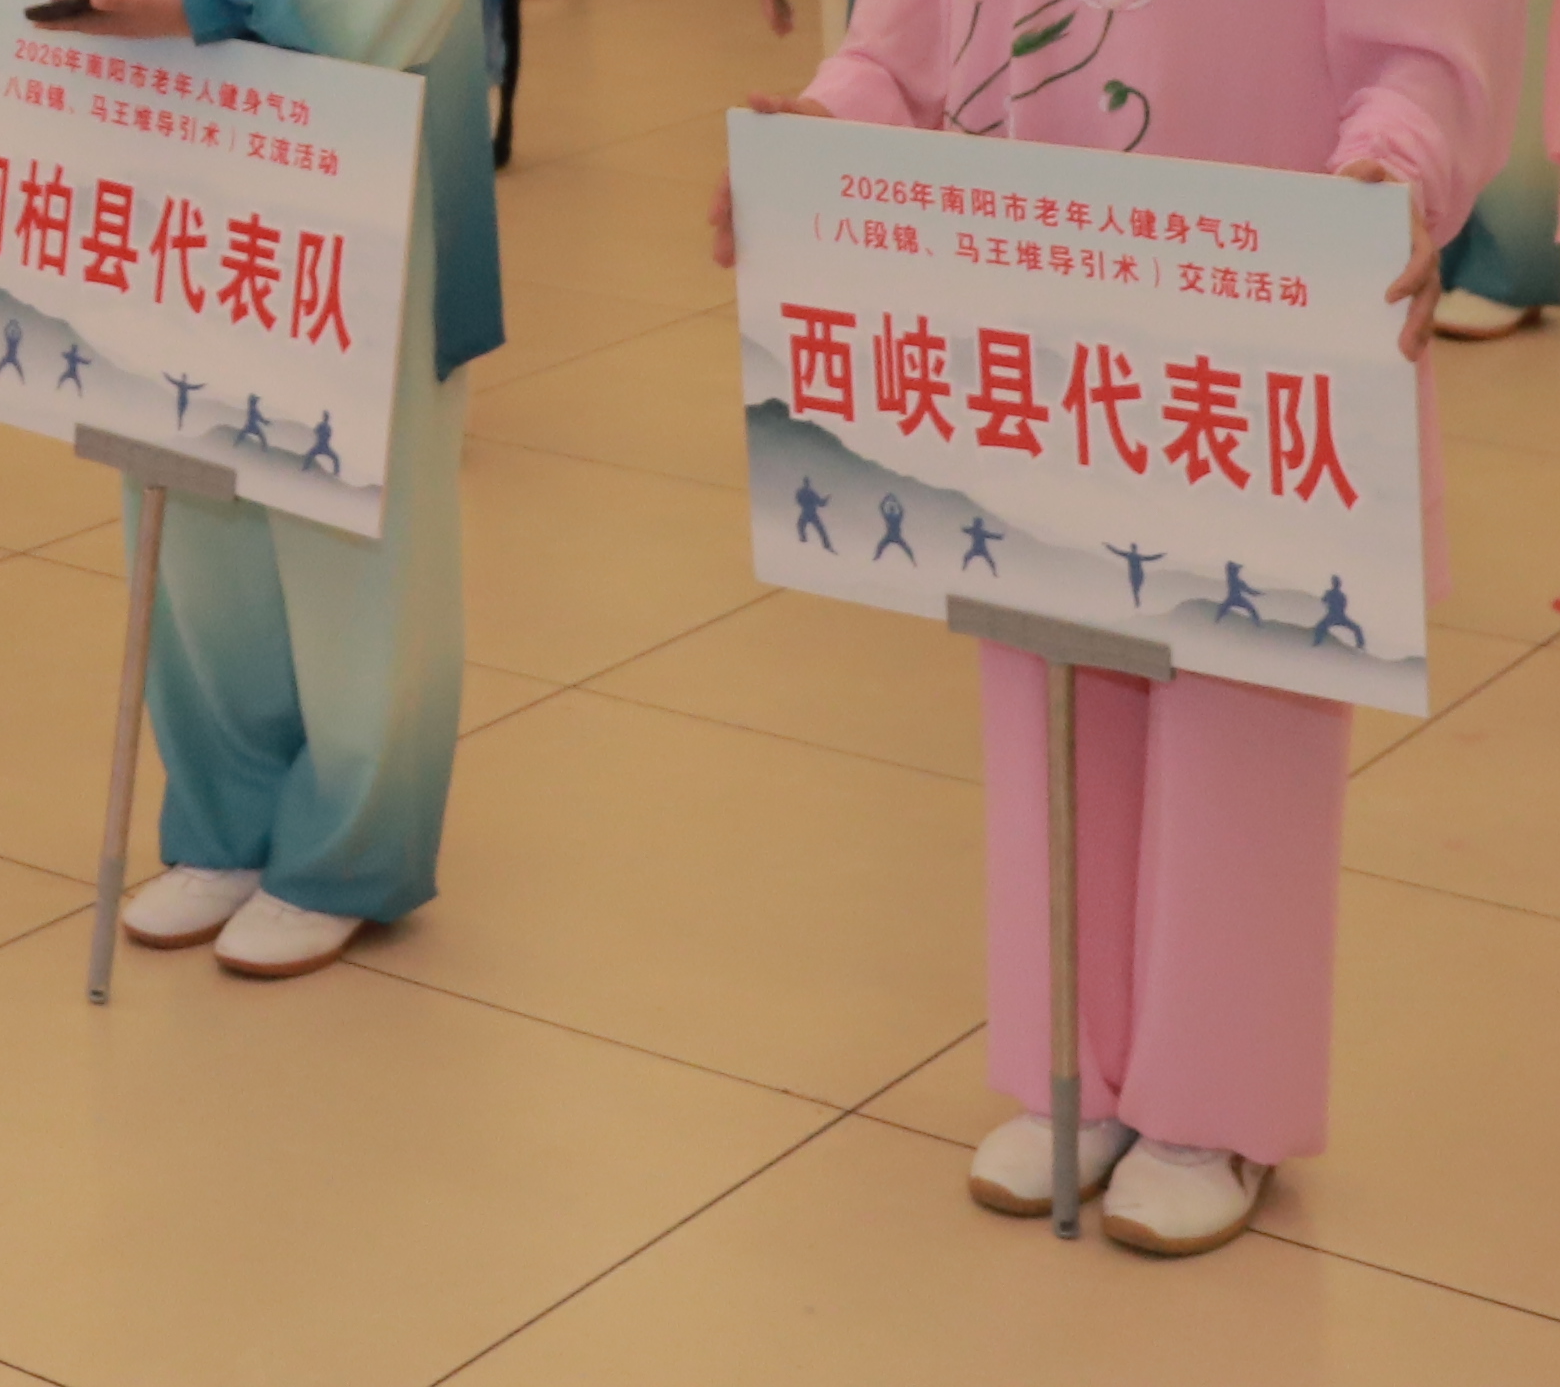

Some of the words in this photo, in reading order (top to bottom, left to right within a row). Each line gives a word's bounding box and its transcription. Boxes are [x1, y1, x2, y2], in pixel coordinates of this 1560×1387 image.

[14, 37, 312, 127] 2026年南阳市老年人健身气功
[840, 173, 1259, 252] 2026年南阳市老年人健身气功
[780, 302, 1359, 510] 西峡县代表队
